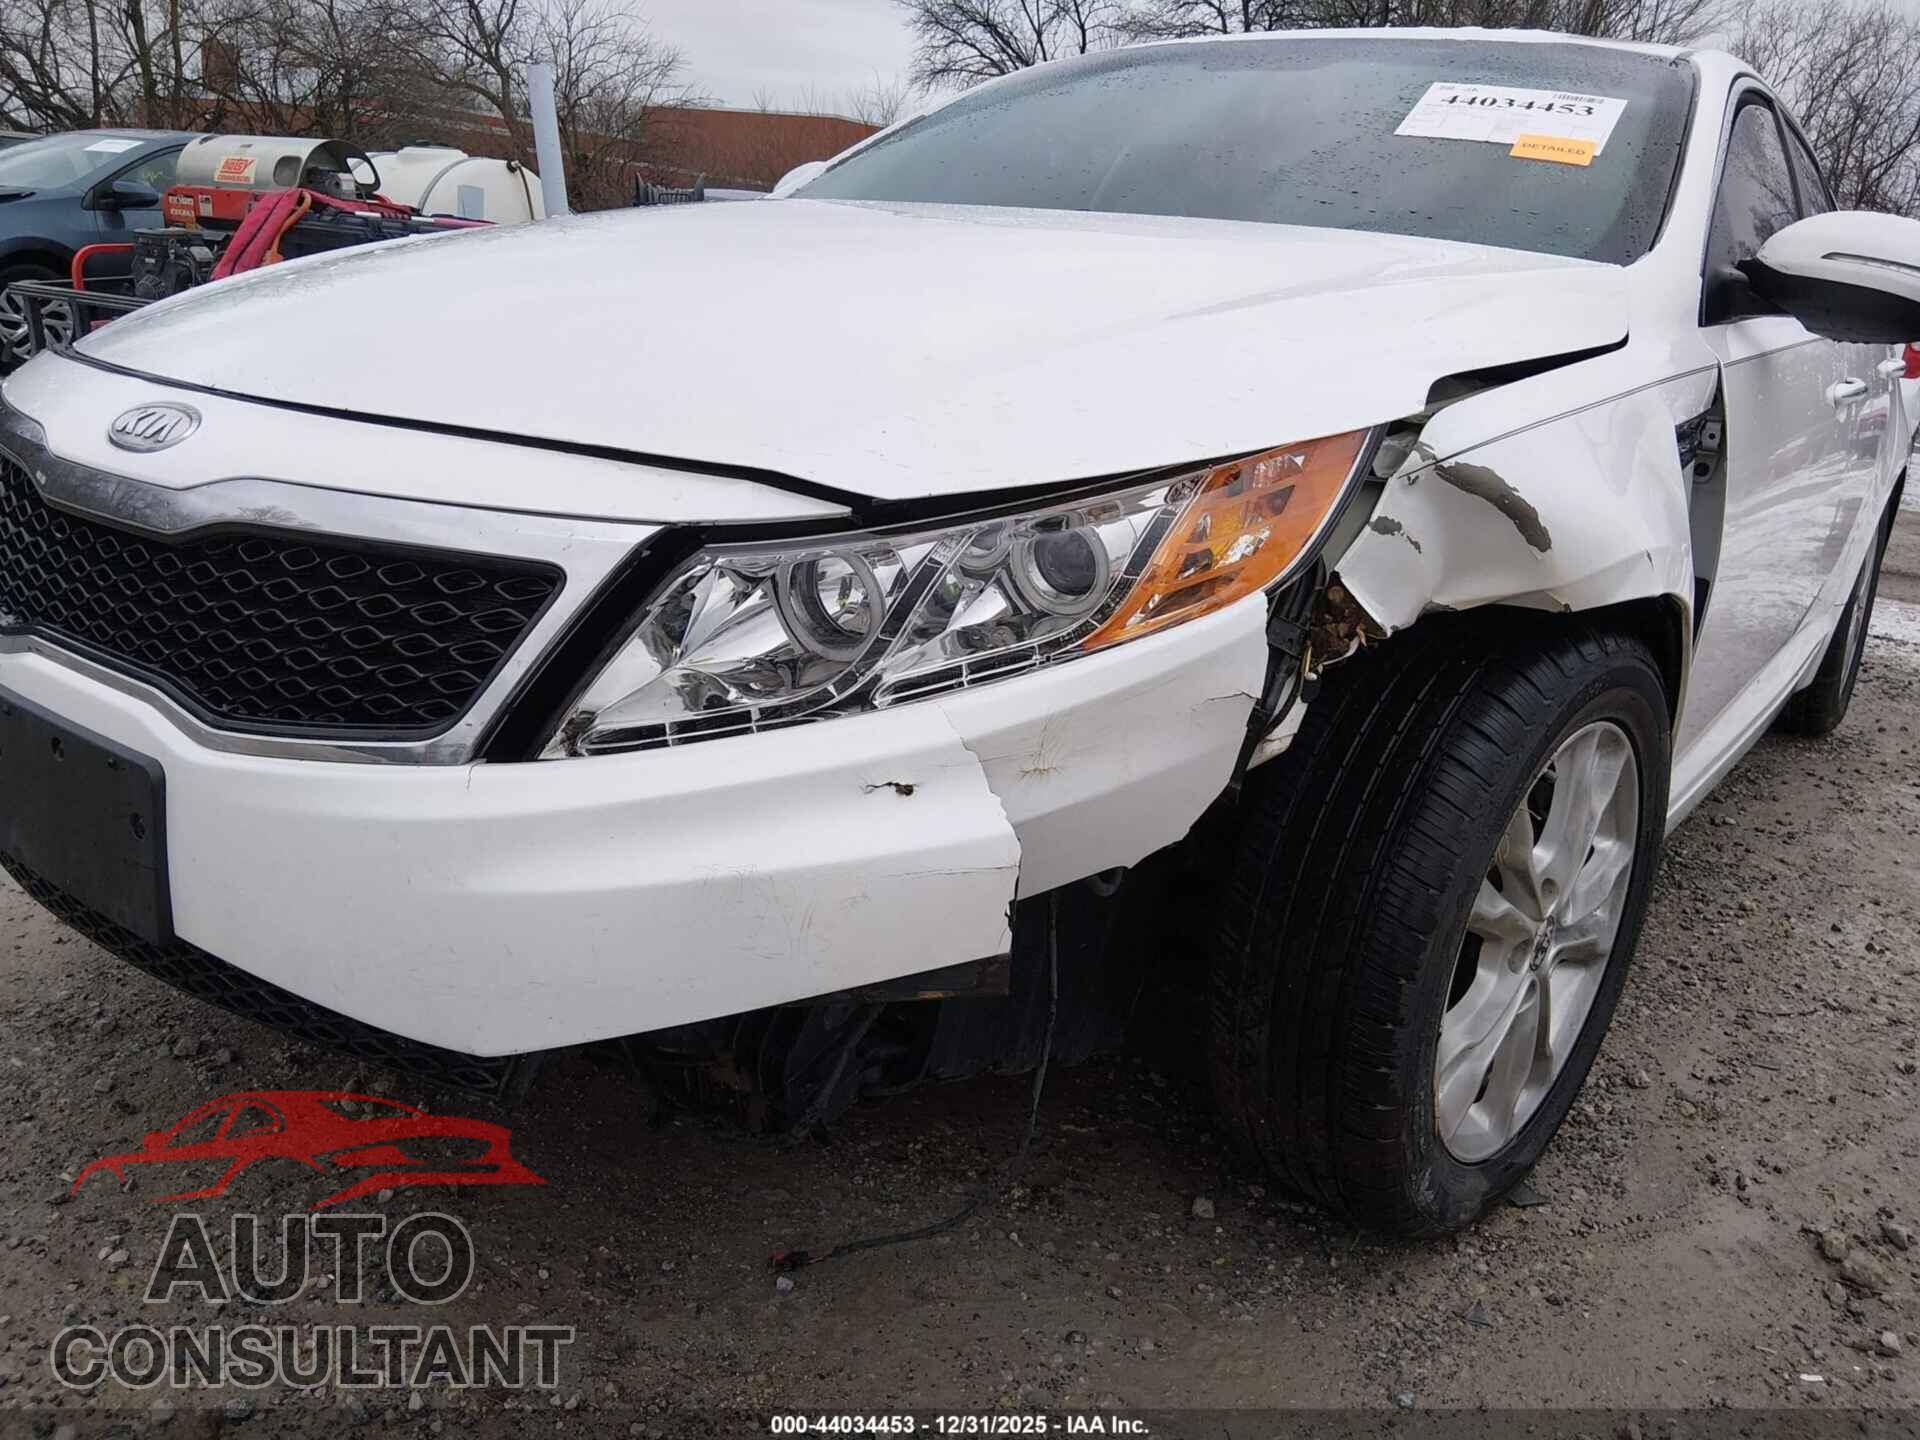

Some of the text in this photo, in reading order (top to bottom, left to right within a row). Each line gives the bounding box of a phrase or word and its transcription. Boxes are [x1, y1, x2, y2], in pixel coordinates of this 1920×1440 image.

[1440, 95, 1595, 116] 44034453
[1521, 142, 1586, 155] DETAILED
[115, 409, 184, 444] KIA
